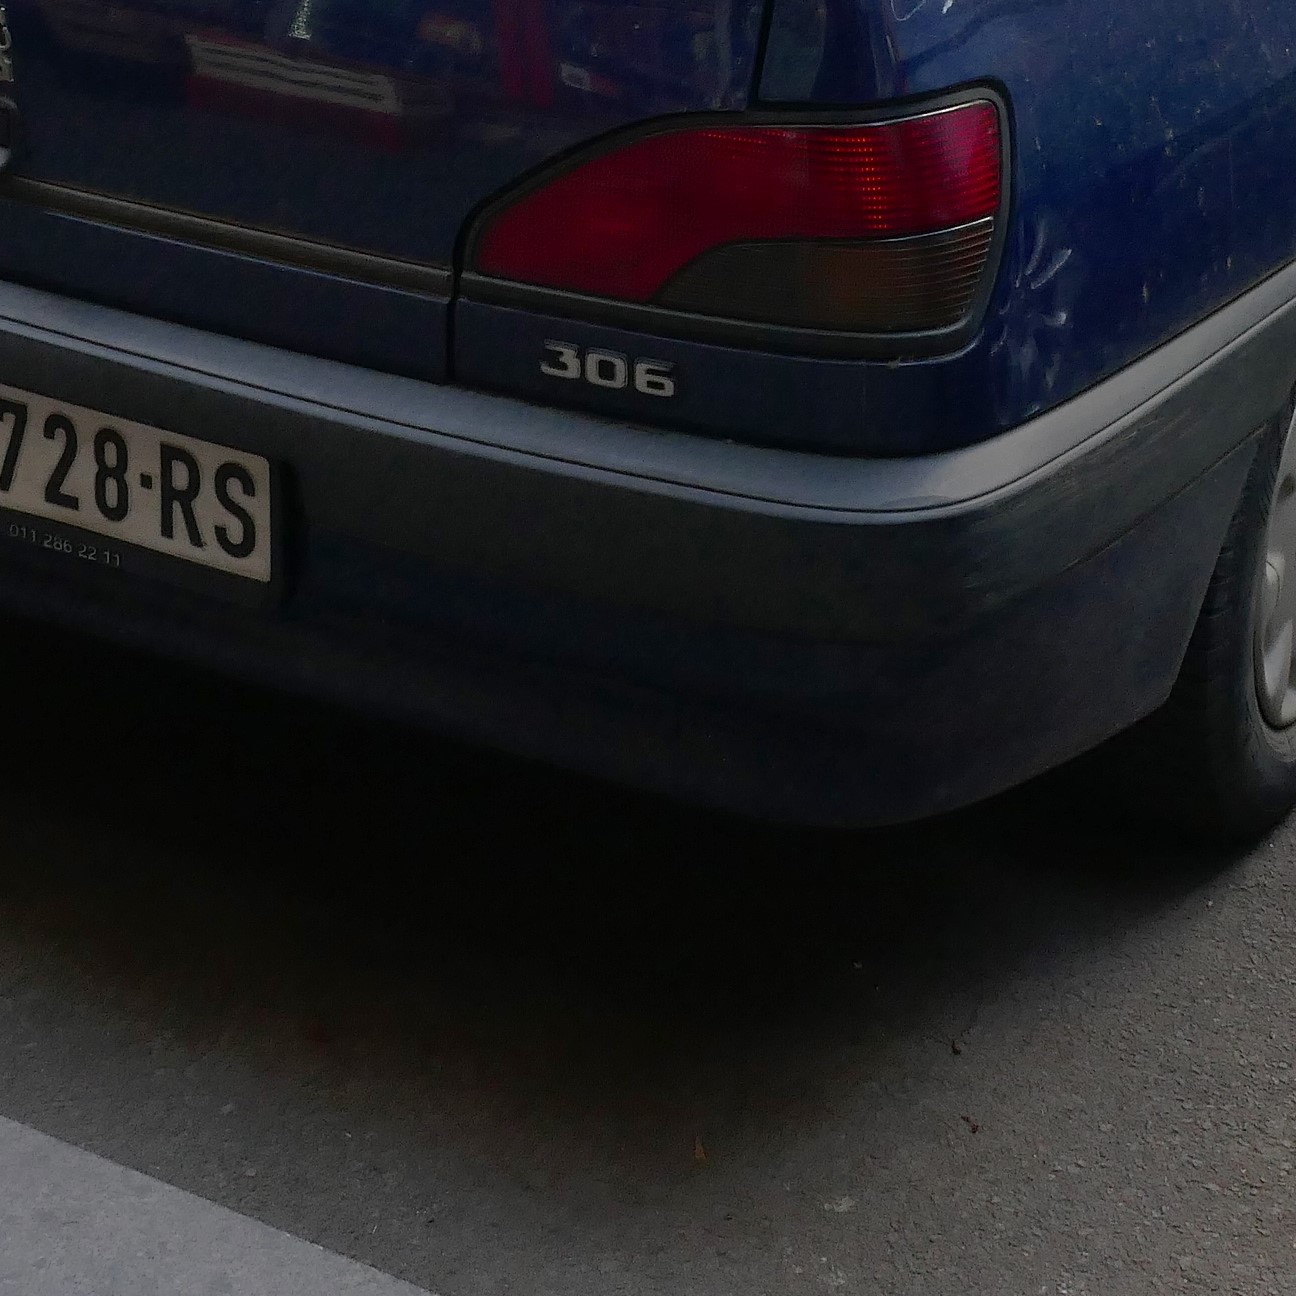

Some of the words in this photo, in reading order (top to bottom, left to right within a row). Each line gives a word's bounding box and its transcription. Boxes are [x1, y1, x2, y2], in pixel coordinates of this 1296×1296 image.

[540, 339, 677, 397] 306
[78, 544, 98, 561] 22
[103, 549, 121, 567] 11
